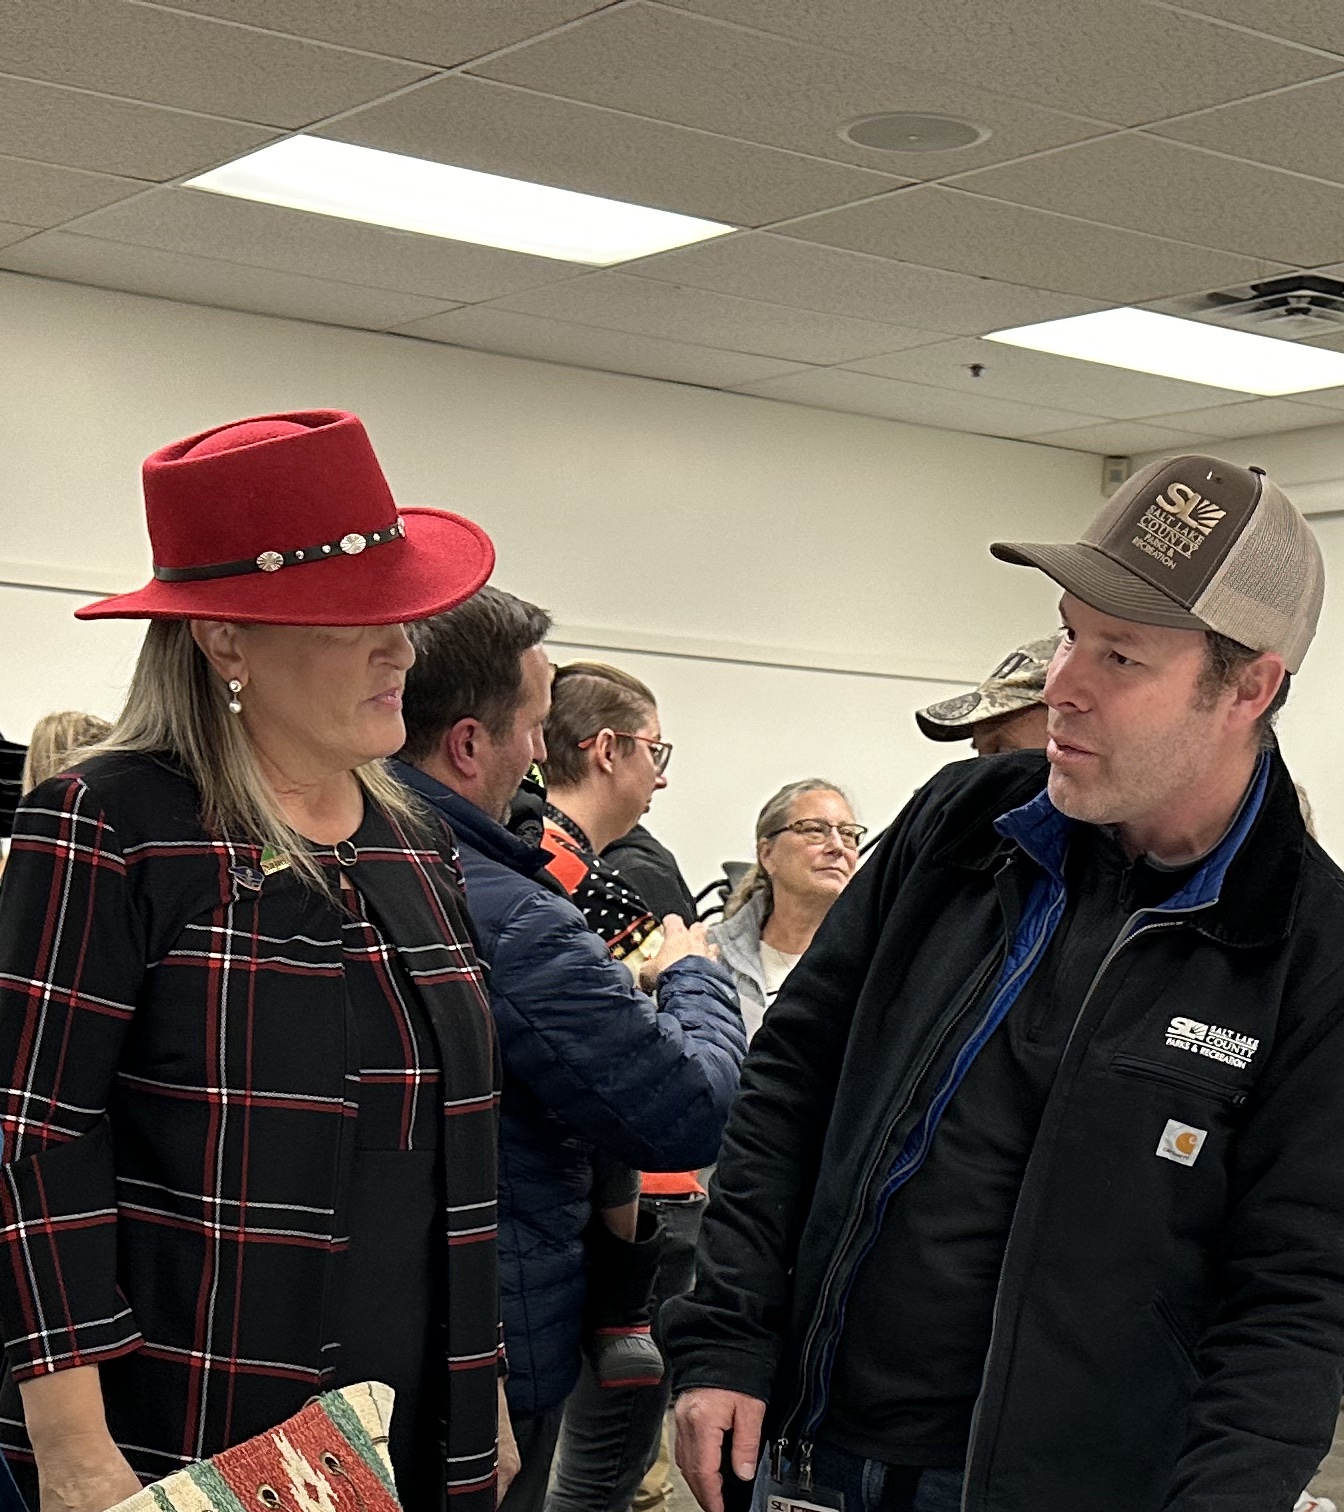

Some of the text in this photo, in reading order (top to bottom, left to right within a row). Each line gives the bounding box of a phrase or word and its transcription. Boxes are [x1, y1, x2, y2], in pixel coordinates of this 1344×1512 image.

[1140, 515, 1199, 556] COUNTY
[1147, 504, 1205, 545] SALT LAKE
[1206, 1036, 1256, 1058] COUNTY
[1209, 1025, 1260, 1048] SALT LAKE
[1166, 1038, 1190, 1051] PARKS
[1200, 1047, 1247, 1069] RECREATION
